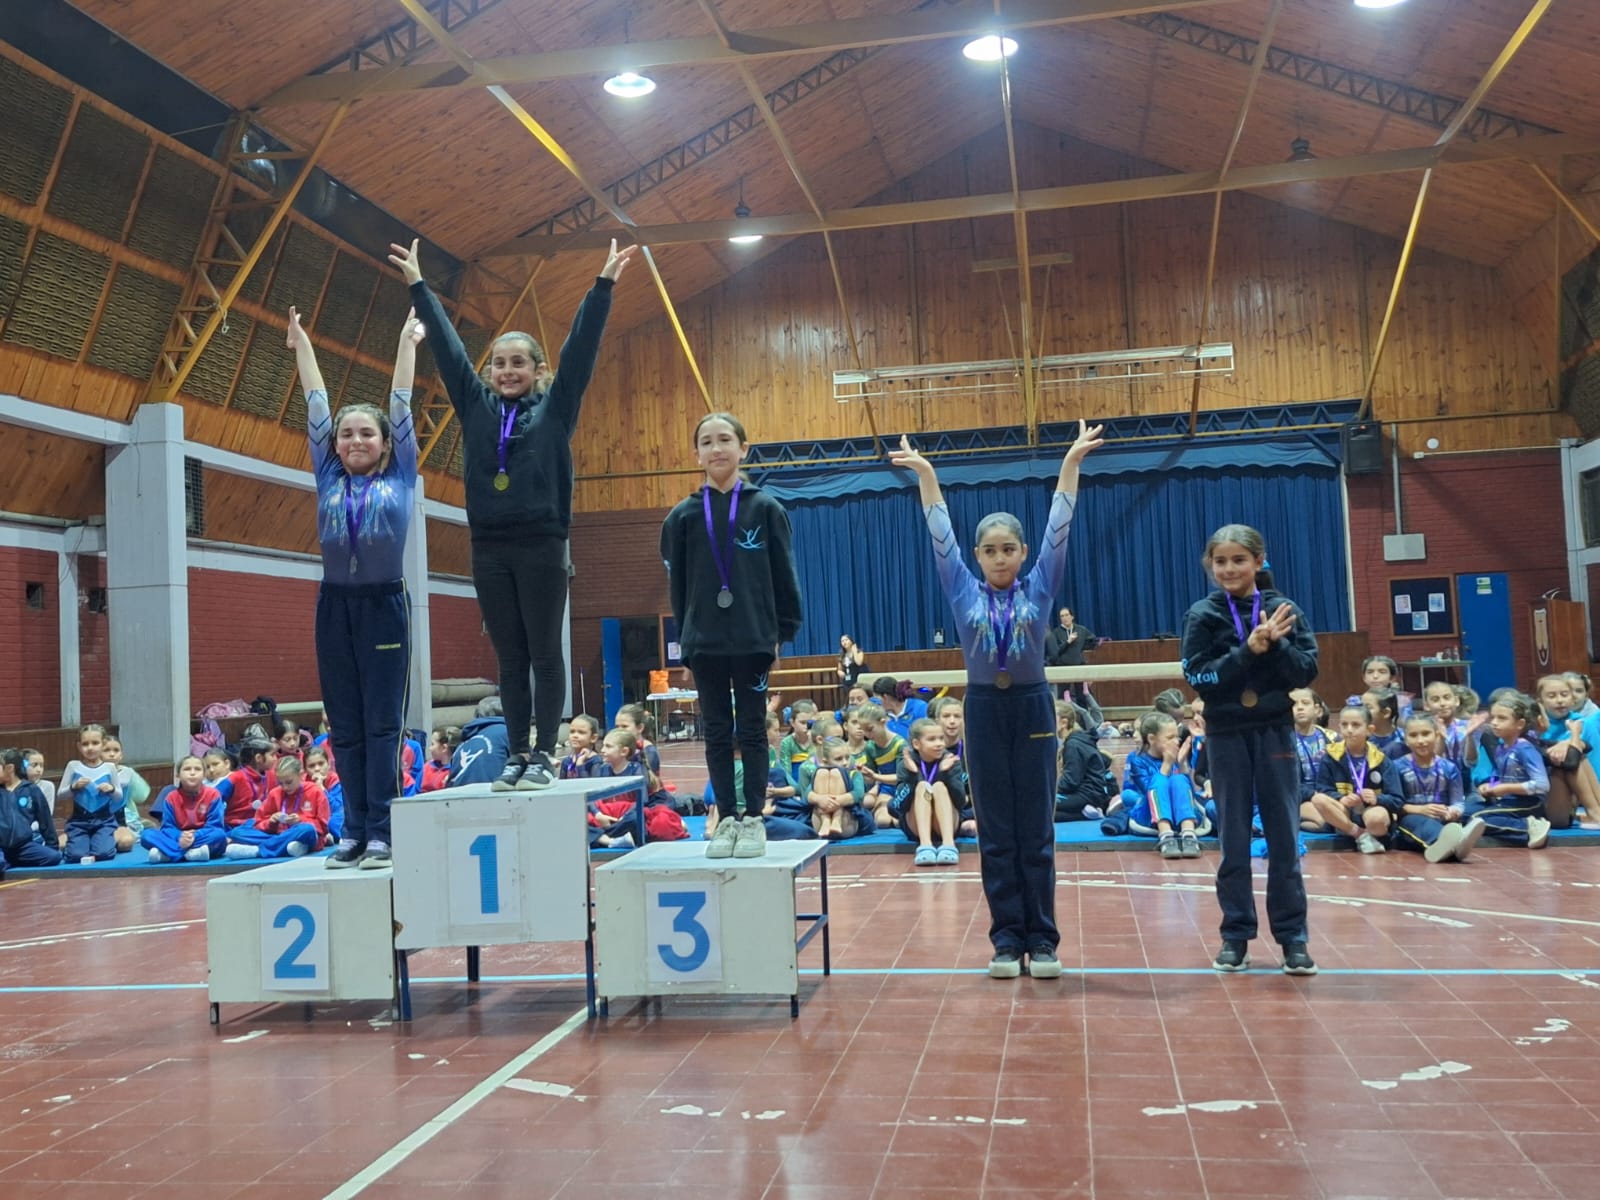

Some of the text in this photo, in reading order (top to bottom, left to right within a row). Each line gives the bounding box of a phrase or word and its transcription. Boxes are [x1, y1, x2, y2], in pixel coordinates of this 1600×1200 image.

[469, 835, 499, 914] 1
[273, 904, 316, 979] 2
[657, 891, 710, 973] 3
